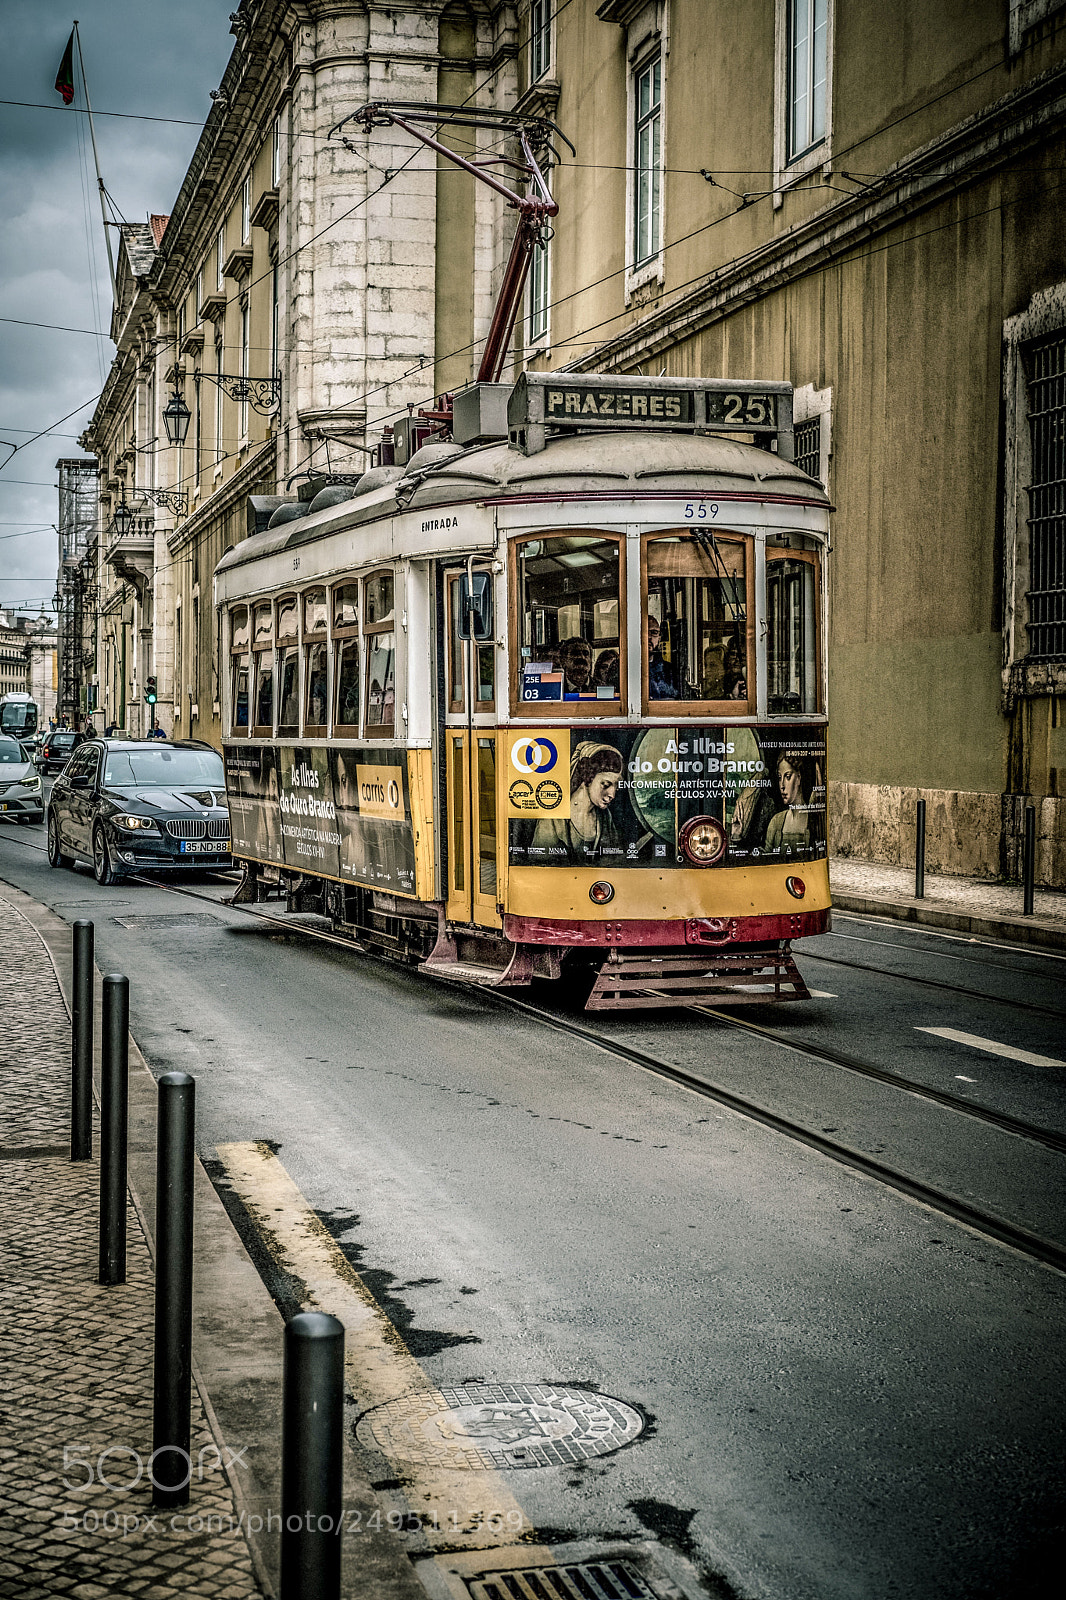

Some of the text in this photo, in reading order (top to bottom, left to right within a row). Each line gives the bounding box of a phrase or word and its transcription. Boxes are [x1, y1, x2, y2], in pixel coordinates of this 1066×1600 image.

[548, 391, 681, 417] PRAZERES
[684, 503, 720, 519] 559
[421, 516, 458, 532] ENTRADA
[524, 689, 539, 699] 03
[665, 737, 735, 754] As Ilhas
[628, 757, 765, 773] do Ouro Branco
[291, 762, 319, 788] As Ilhas
[361, 776, 385, 803] carris
[618, 778, 772, 789] ENCOMENDA ARTÍSTICA NA MADEIRA
[664, 789, 735, 799] SÉCULOS XV-XVI
[280, 789, 336, 820] do Ouro Branco
